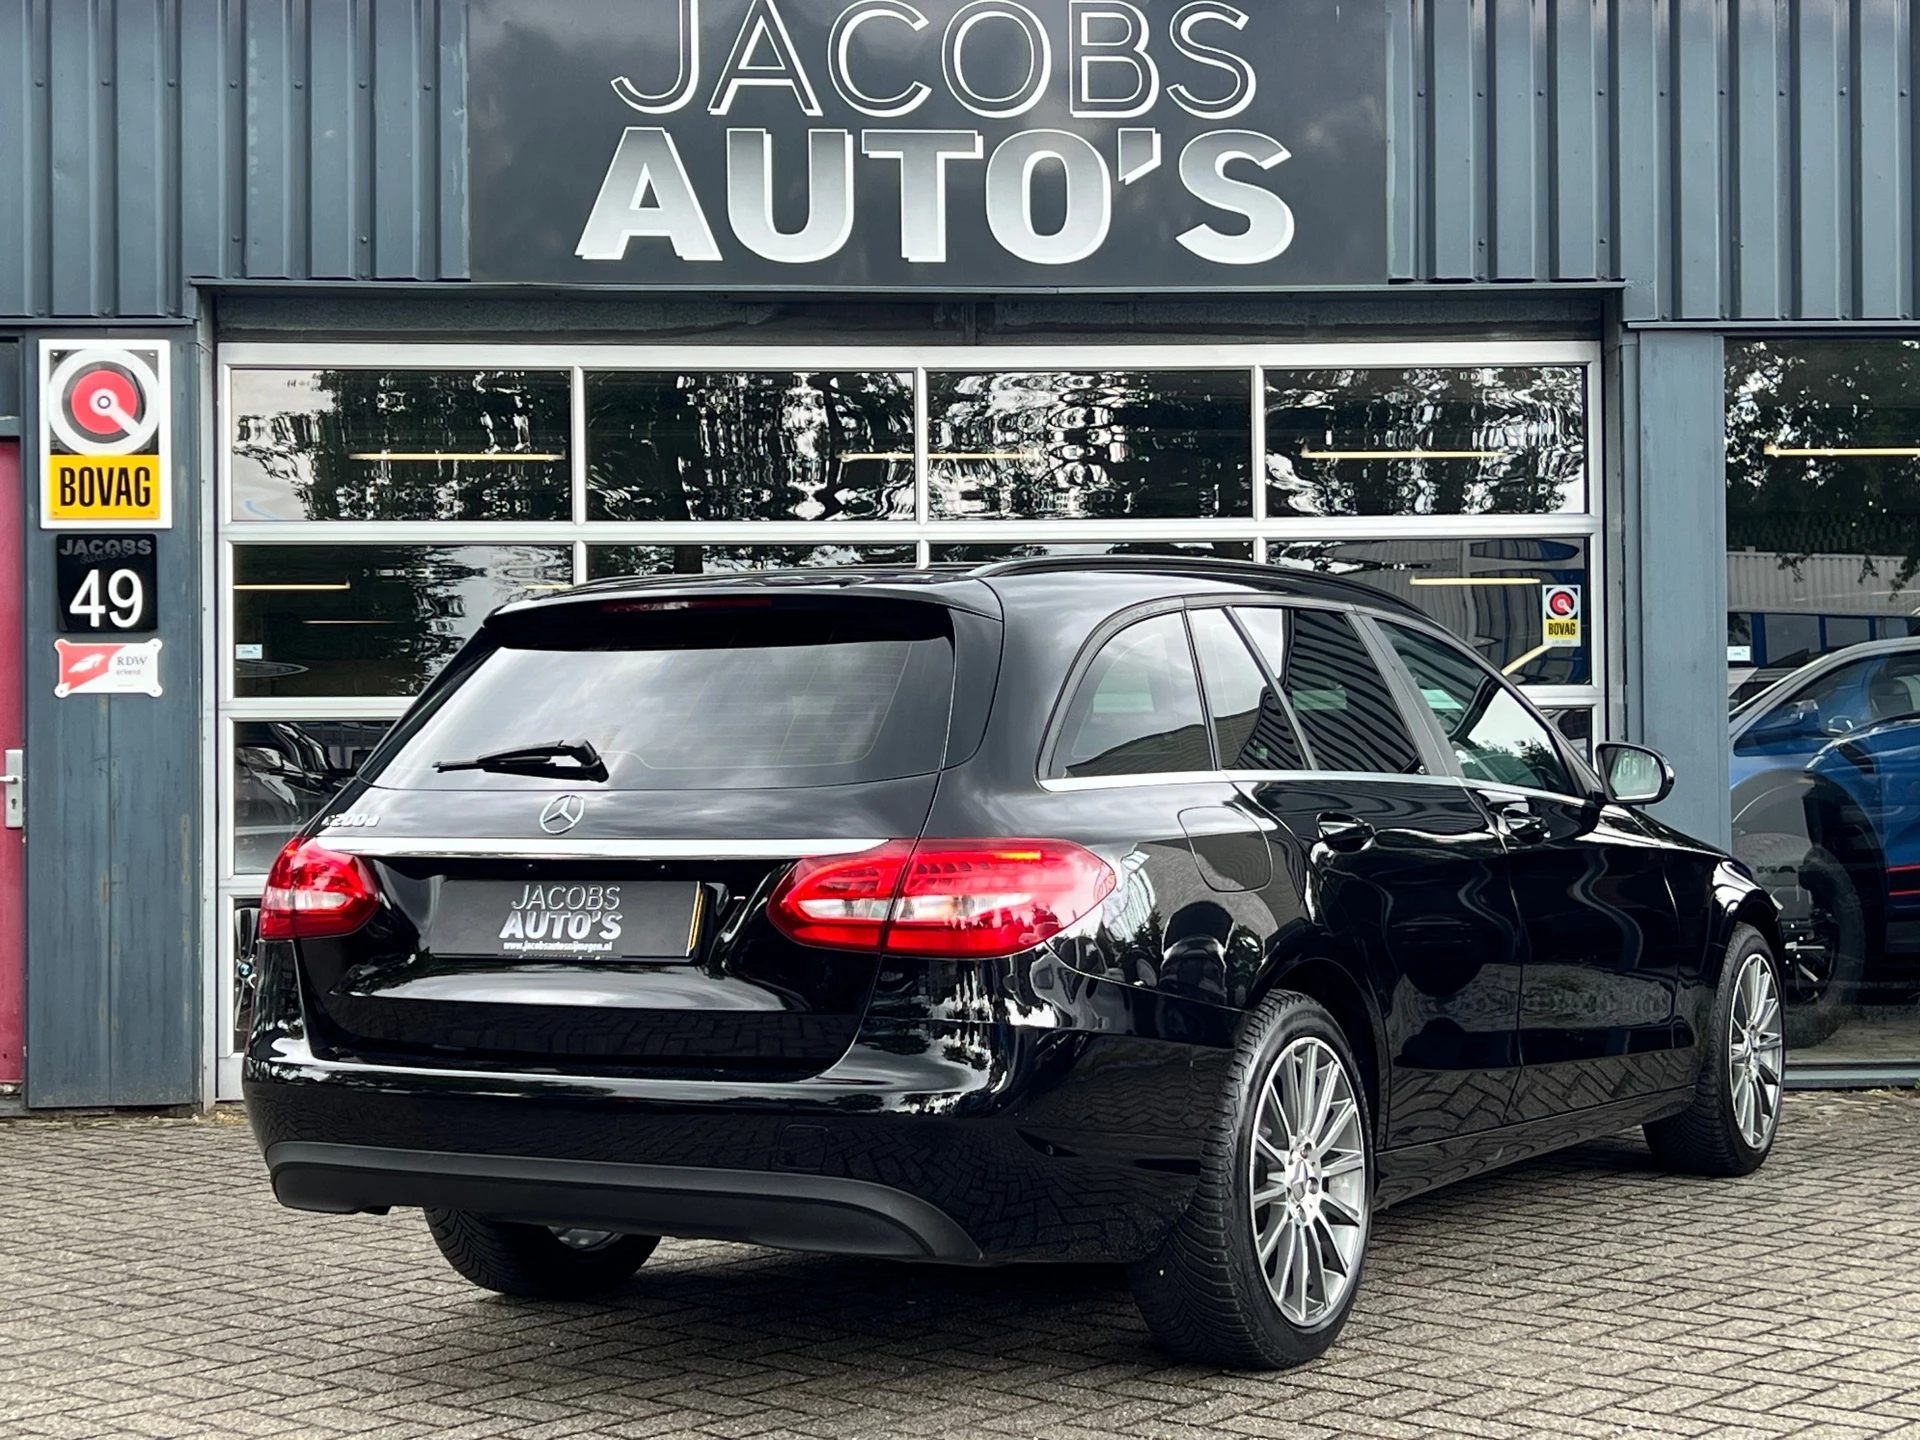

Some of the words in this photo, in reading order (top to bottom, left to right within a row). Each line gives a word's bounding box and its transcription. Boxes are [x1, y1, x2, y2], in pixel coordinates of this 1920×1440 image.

[610, 0, 1256, 119] JACOBS
[575, 127, 1294, 264] AUTO'S
[60, 466, 151, 507] BOVAG
[59, 539, 152, 556] JACOBS
[69, 568, 143, 628] 49
[1548, 622, 1576, 636] BOVAG
[116, 656, 148, 666] RDW
[511, 884, 620, 911] JACOBS
[498, 910, 623, 940] AUTO'S
